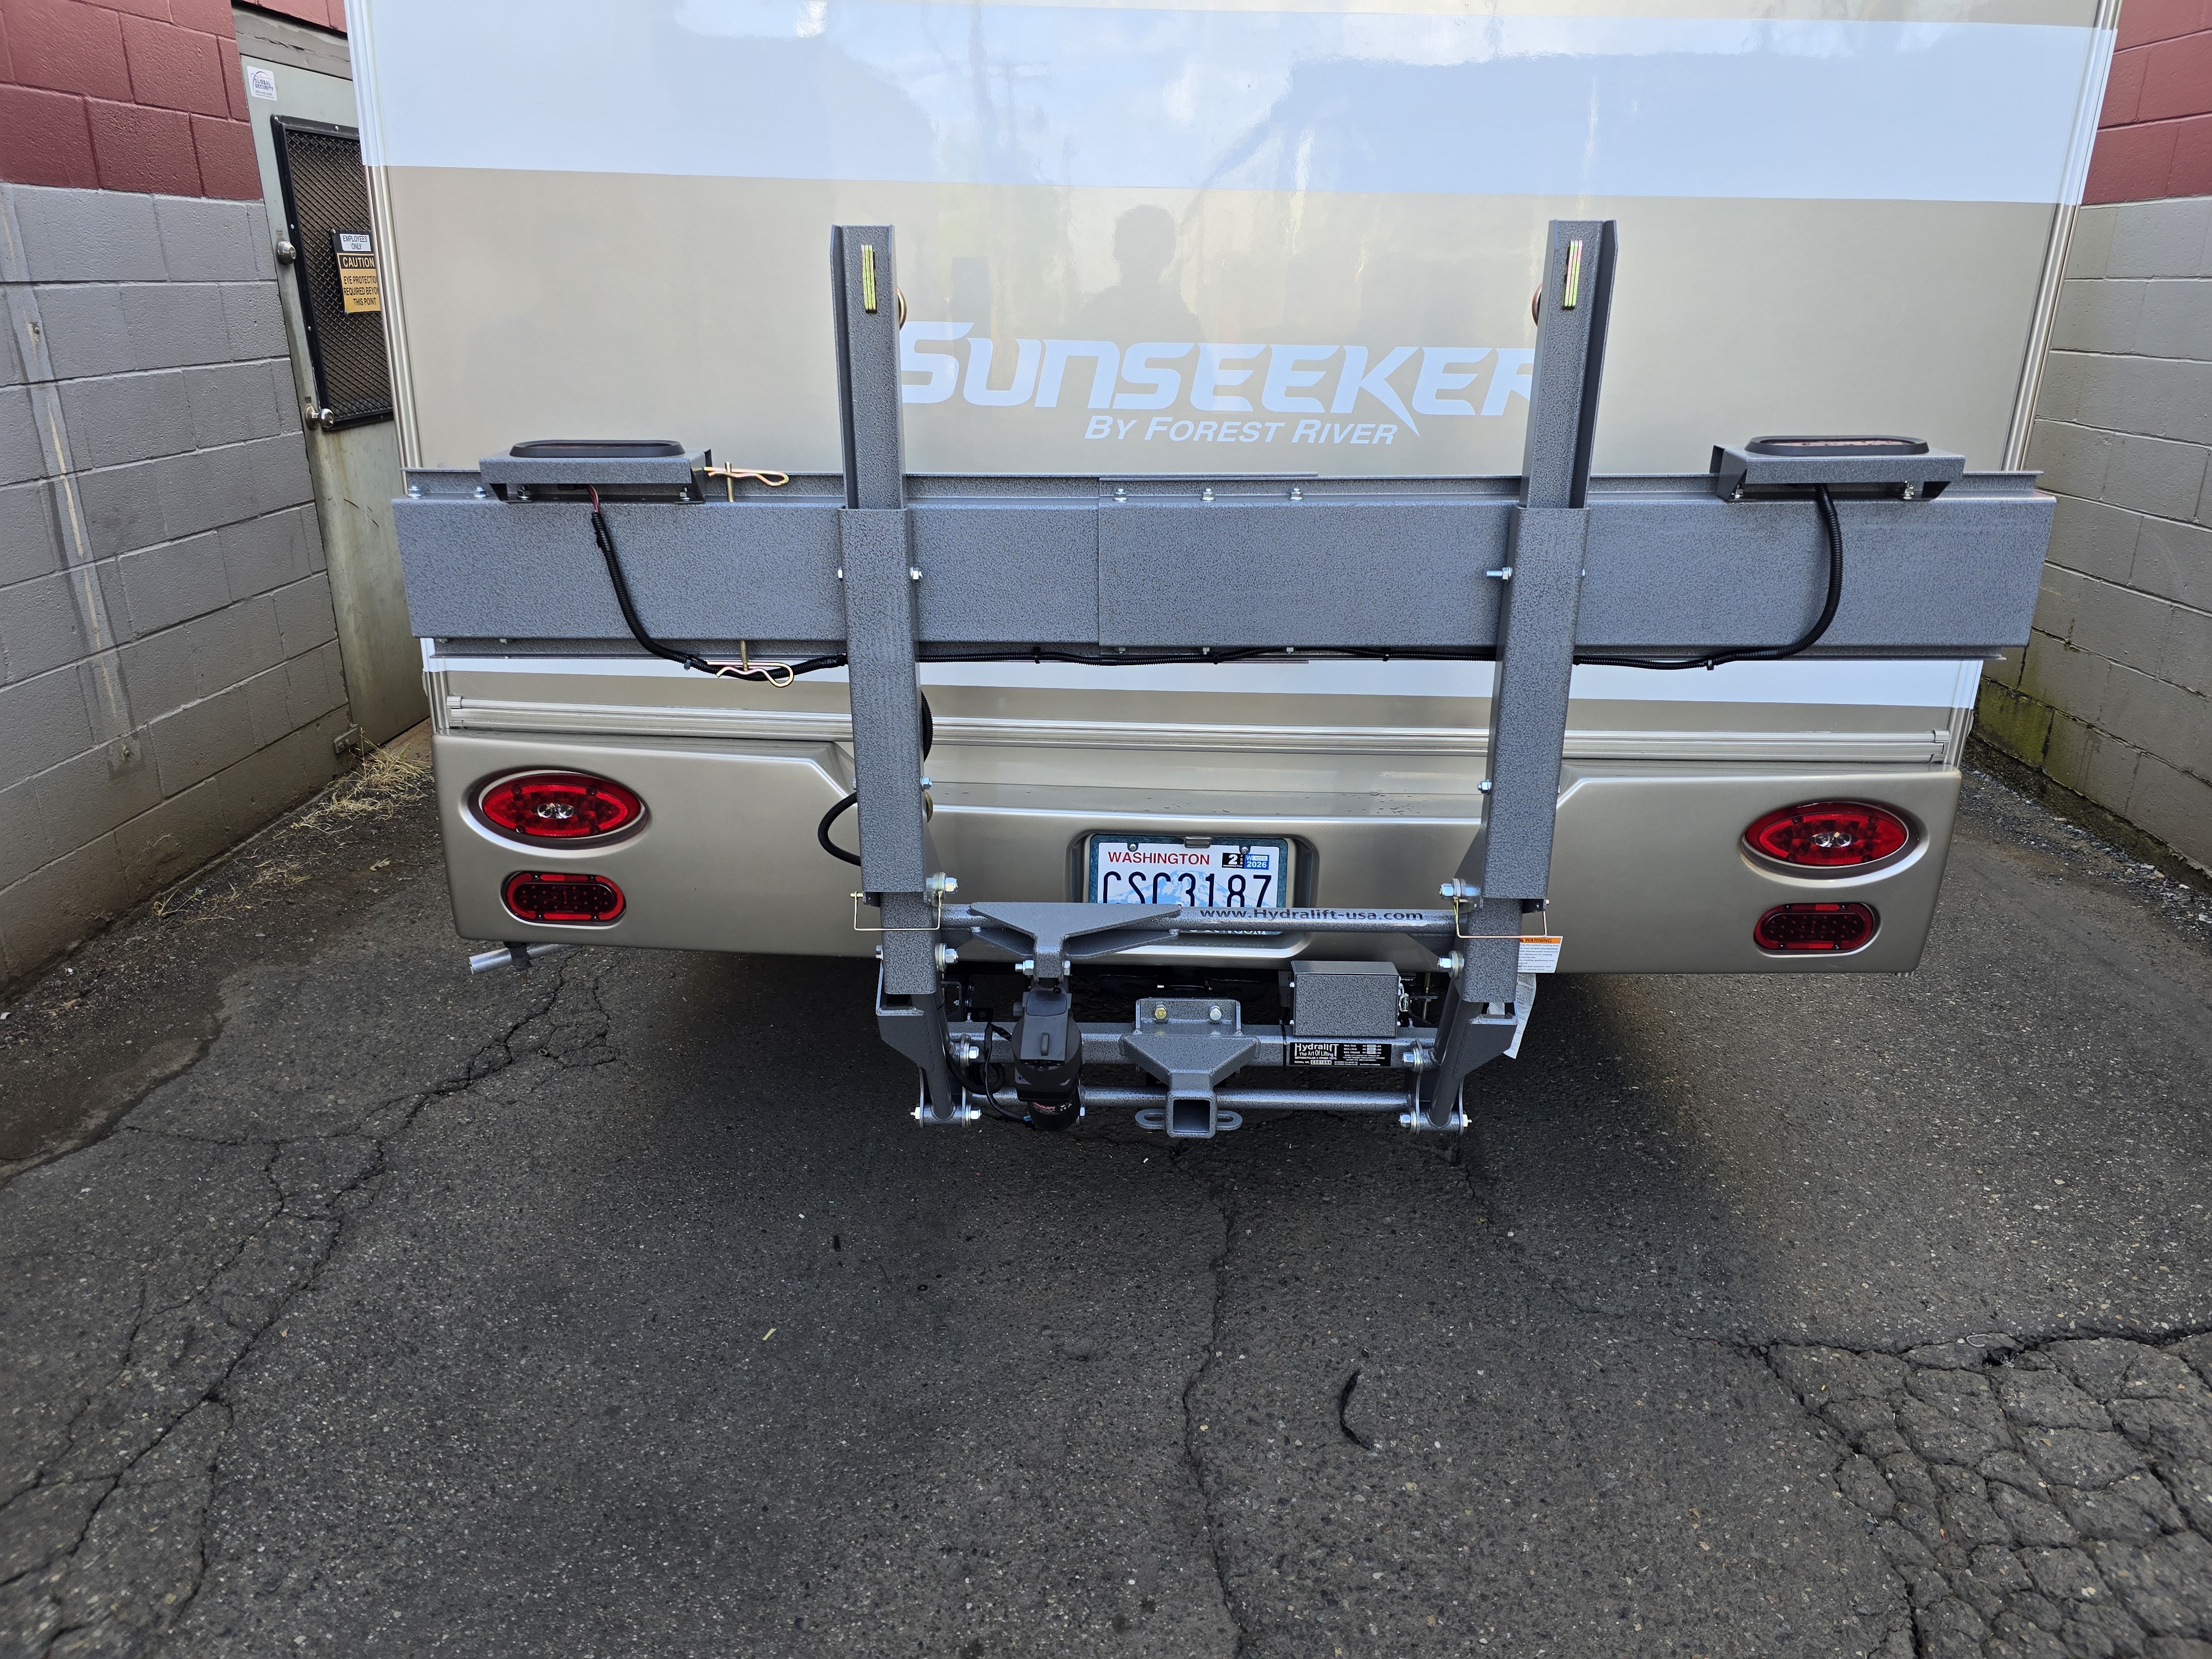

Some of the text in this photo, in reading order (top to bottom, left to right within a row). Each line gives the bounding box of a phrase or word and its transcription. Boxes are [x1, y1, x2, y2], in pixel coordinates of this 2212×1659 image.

[342, 257, 375, 268] CAUTION
[343, 275, 377, 284] EYE PROTECTIO
[343, 286, 378, 296] REQUIRED BEYO
[899, 320, 1536, 437] SUNSEEKER
[1144, 416, 1285, 442] FOREST
[1291, 419, 1398, 444] RIVER
[1108, 851, 1210, 865] WASHINGTON
[1228, 854, 1238, 865] 2
[1199, 909, 1423, 920] www.Hydralift-usa.com
